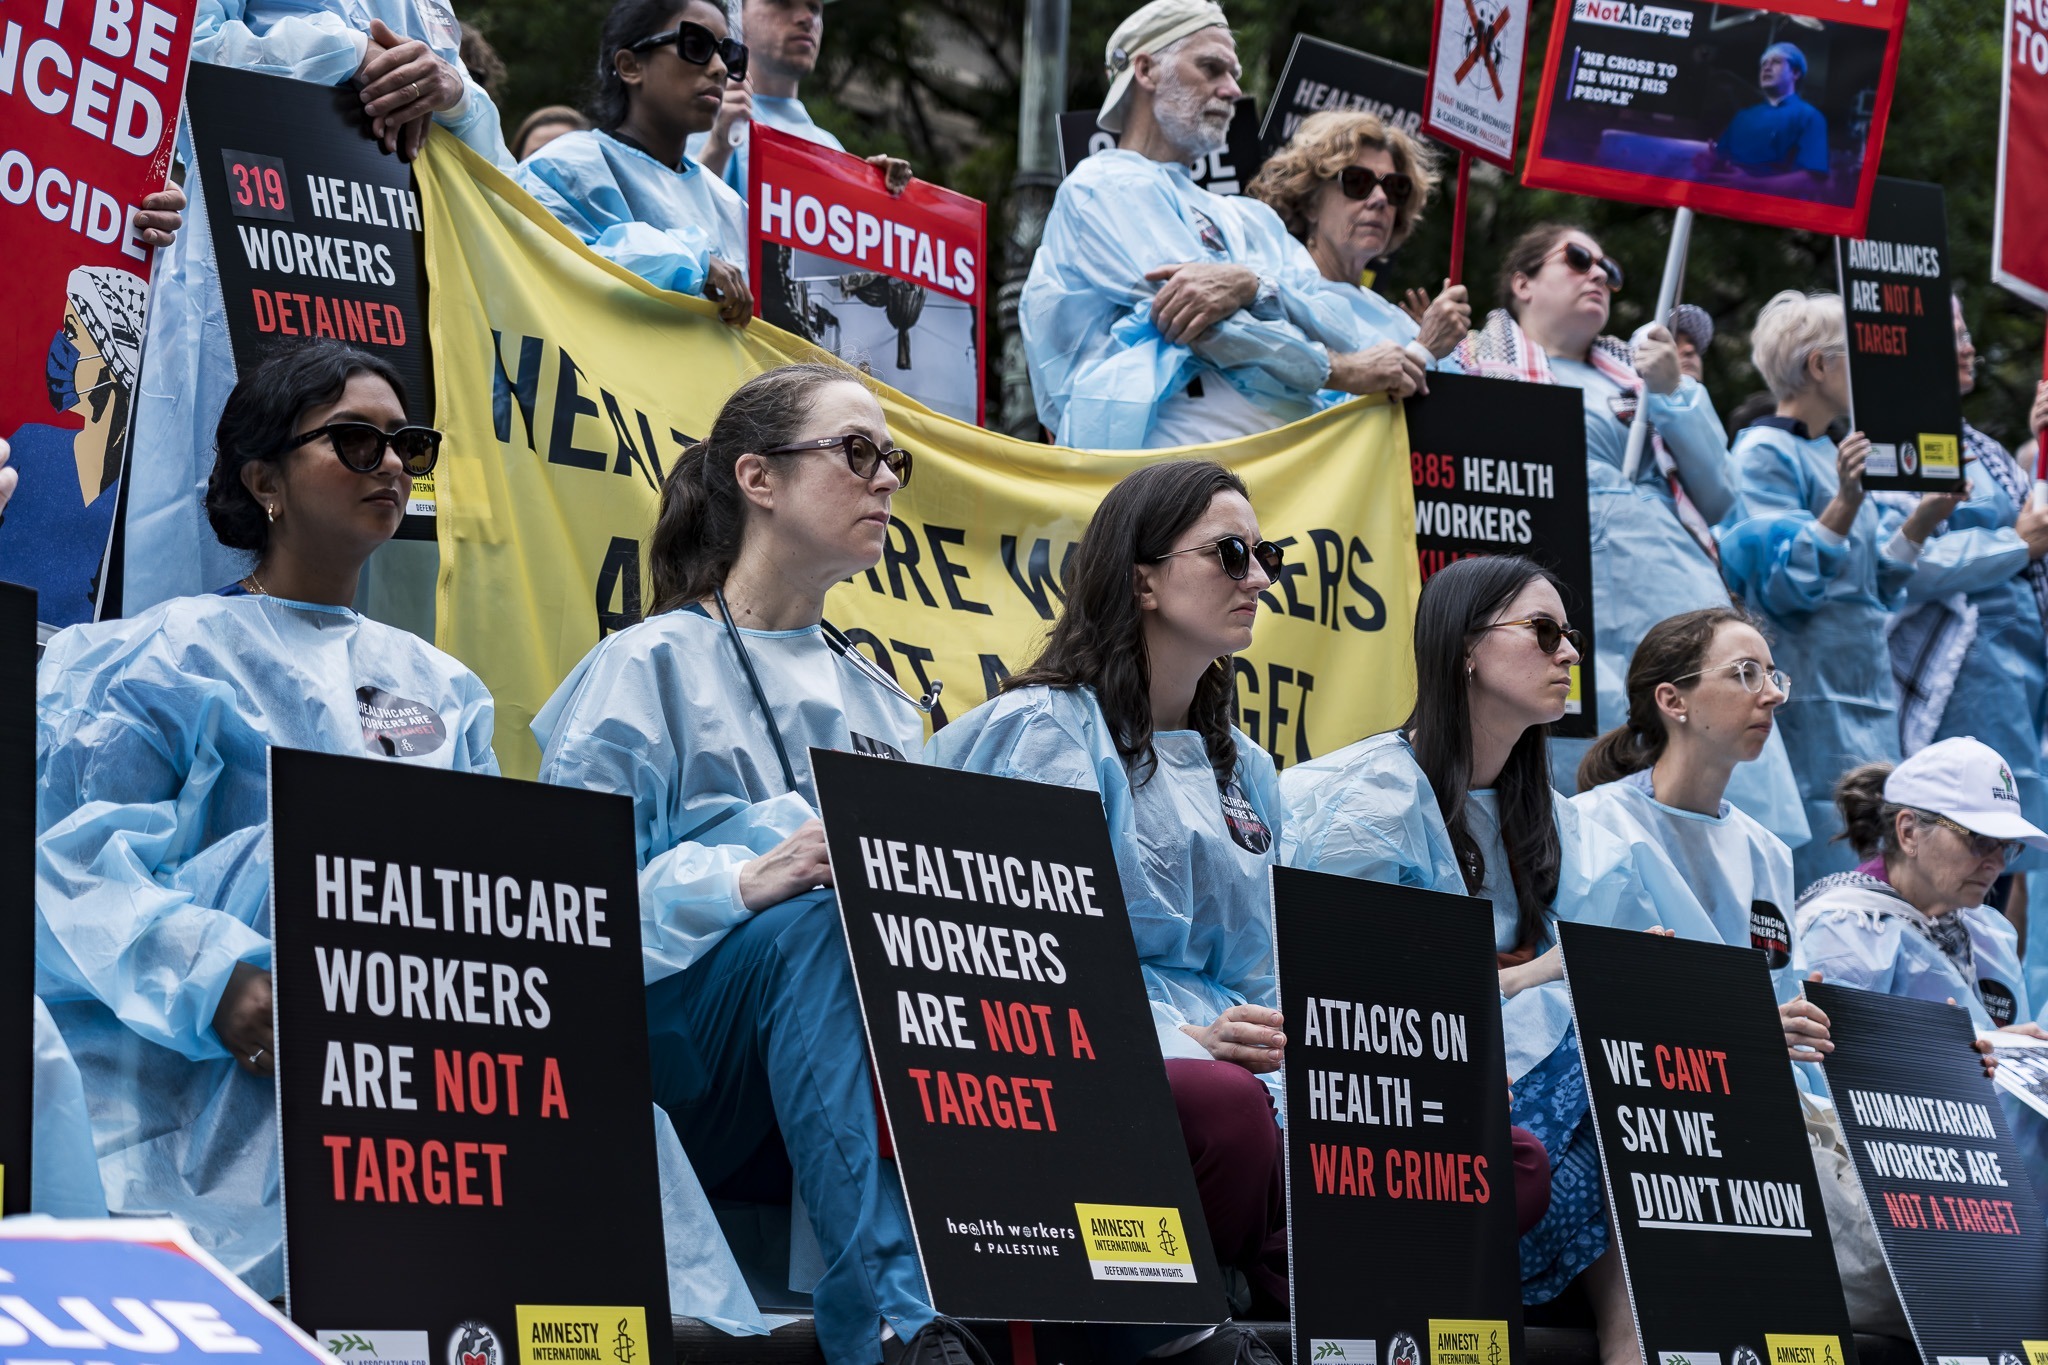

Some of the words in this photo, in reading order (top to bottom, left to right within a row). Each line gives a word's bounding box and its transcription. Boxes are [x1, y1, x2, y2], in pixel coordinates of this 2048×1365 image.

[90, 0, 177, 83] BE
[1577, 67, 1597, 83] BE
[1599, 71, 1640, 90] WITH
[1641, 77, 1668, 95] HIS
[1606, 55, 1656, 75] CHOSE
[1657, 62, 1678, 79] TO
[233, 163, 286, 211] 319
[307, 174, 423, 232] HEALTH
[237, 224, 397, 286] WORKERS
[760, 182, 976, 297] HOSPITALS
[1848, 238, 1940, 278] AMBULANCES
[251, 288, 407, 347] DETAINED
[1852, 280, 1881, 312] ARE
[1883, 284, 1911, 315] NOT
[1913, 286, 1924, 316] A
[1855, 322, 1908, 356] TARGET
[1463, 456, 1554, 499] HEALTH
[1415, 500, 1533, 545] WORKERS
[357, 700, 421, 718] HEALTHCARE
[409, 714, 432, 726] ARE
[315, 854, 611, 948] HEALTHCARE
[859, 836, 1104, 918] HEALTHCARE
[872, 912, 1067, 985] WORKERS
[314, 946, 551, 1029] WORKERS
[897, 990, 976, 1050] ARE
[980, 999, 1056, 1057] NOT
[1068, 1008, 1096, 1061] A
[1305, 996, 1423, 1058] ATTACKS
[1431, 1011, 1468, 1063] ON
[321, 1041, 418, 1111] ARE
[434, 1048, 523, 1118] NOT
[540, 1057, 570, 1119] A
[1600, 1038, 1652, 1088] WE
[1655, 1044, 1731, 1095] CAN'T
[908, 1069, 1058, 1132] TARGET
[1308, 1069, 1413, 1128] HEALTH
[1848, 1089, 1997, 1140] HUMANITARIAN
[1617, 1105, 1669, 1154] SAY
[1673, 1110, 1723, 1158] WE
[322, 1135, 507, 1206] TARGET
[1309, 1143, 1376, 1197] WAR
[1385, 1148, 1490, 1204] CRIMES
[1863, 1140, 1967, 1184] WORKERS
[1966, 1149, 2009, 1187] ARE
[1630, 1172, 1723, 1223] DIDN'T
[1727, 1179, 1806, 1228] KNOW
[1883, 1191, 1928, 1230] NOT
[1929, 1195, 1949, 1230] A
[1943, 1196, 2021, 1236] TARGET
[974, 1242, 982, 1253] 4
[988, 1243, 1060, 1257] PALESTINE
[1091, 1217, 1145, 1238] AMNESTY
[1094, 1240, 1152, 1253] INTERNATIONAL
[1104, 1265, 1138, 1276] DEFENDING
[1139, 1267, 1161, 1277] HUMAN
[1161, 1267, 1184, 1278] RIGHTS
[531, 1322, 600, 1345] AMNESTY
[532, 1347, 602, 1361] INTERNATIONAL
[1437, 1333, 1480, 1351] AMNESTY
[1776, 1347, 1816, 1363] AMNESTY
[1438, 1353, 1481, 1365] INTERNATIONAL
